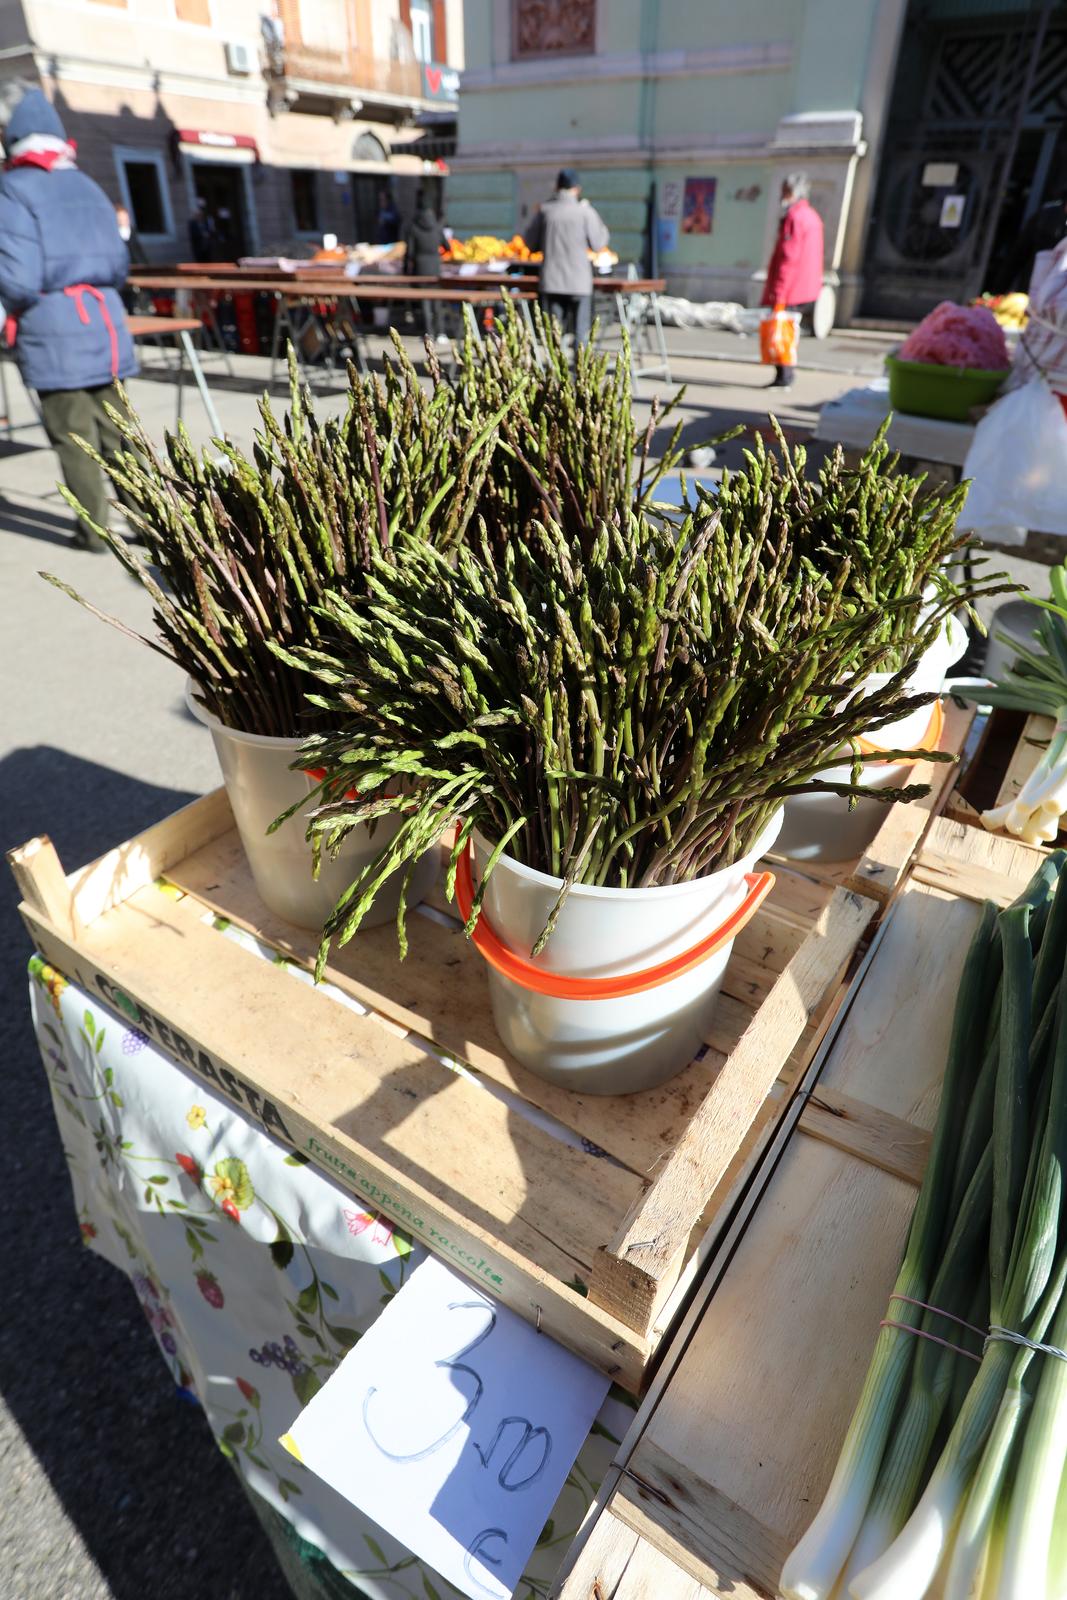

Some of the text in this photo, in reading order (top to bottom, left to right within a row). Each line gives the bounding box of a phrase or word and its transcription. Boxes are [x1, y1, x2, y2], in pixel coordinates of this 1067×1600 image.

[305, 1136, 504, 1286] frutta appena raccolta
